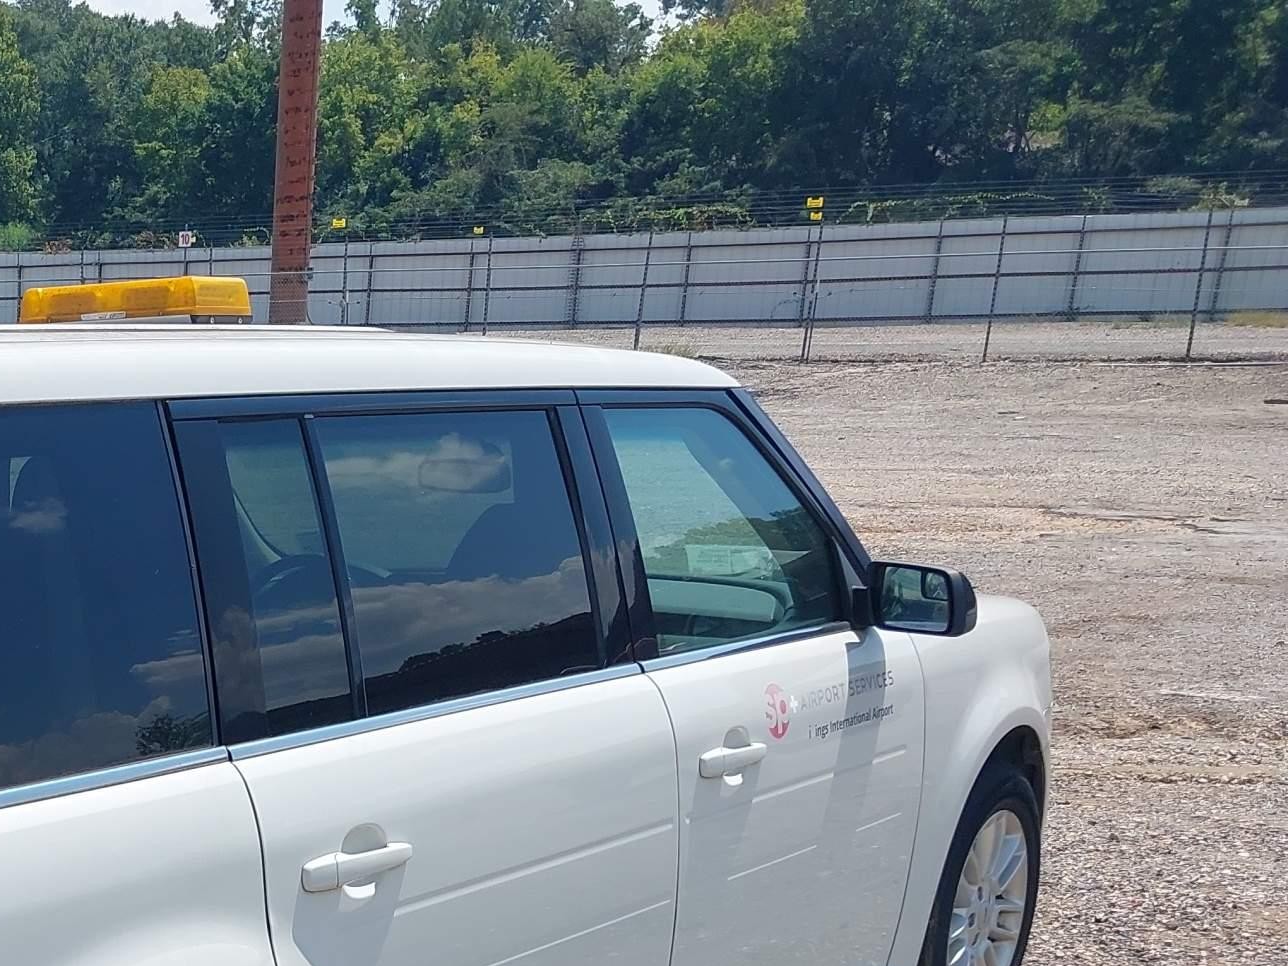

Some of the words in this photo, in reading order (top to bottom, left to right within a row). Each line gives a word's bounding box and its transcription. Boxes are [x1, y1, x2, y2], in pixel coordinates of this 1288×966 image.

[181, 233, 190, 245] 10
[800, 683, 845, 711] AIRPORT
[848, 670, 894, 697] SERVICES
[830, 708, 871, 733] International
[871, 703, 894, 721] Airport
